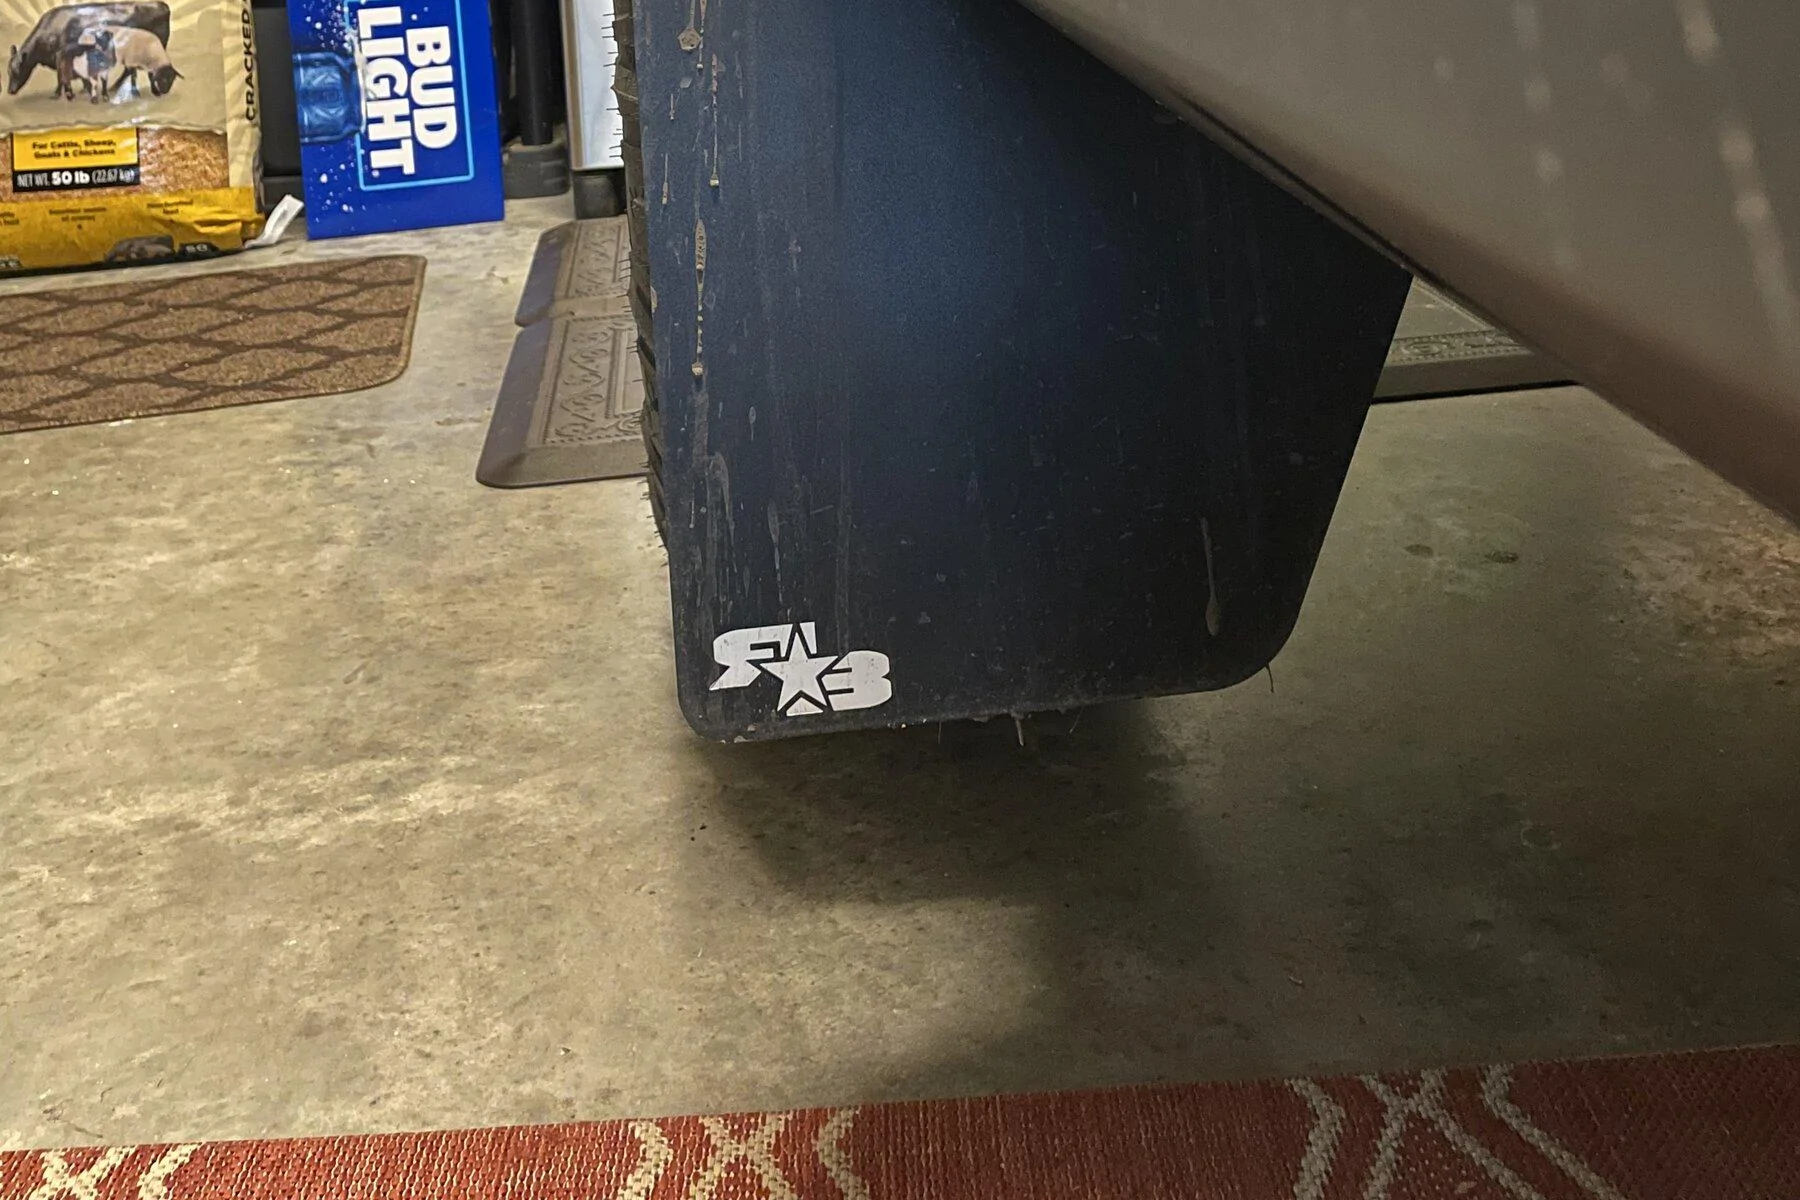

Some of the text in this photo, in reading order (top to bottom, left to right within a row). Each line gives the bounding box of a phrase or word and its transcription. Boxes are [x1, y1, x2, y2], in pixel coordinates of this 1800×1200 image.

[241, 11, 257, 121] CRACKED
[357, 6, 416, 176] LIGHT
[405, 25, 458, 149] BUD
[17, 173, 33, 188] NET
[52, 170, 73, 186] 50
[74, 170, 90, 185] lb
